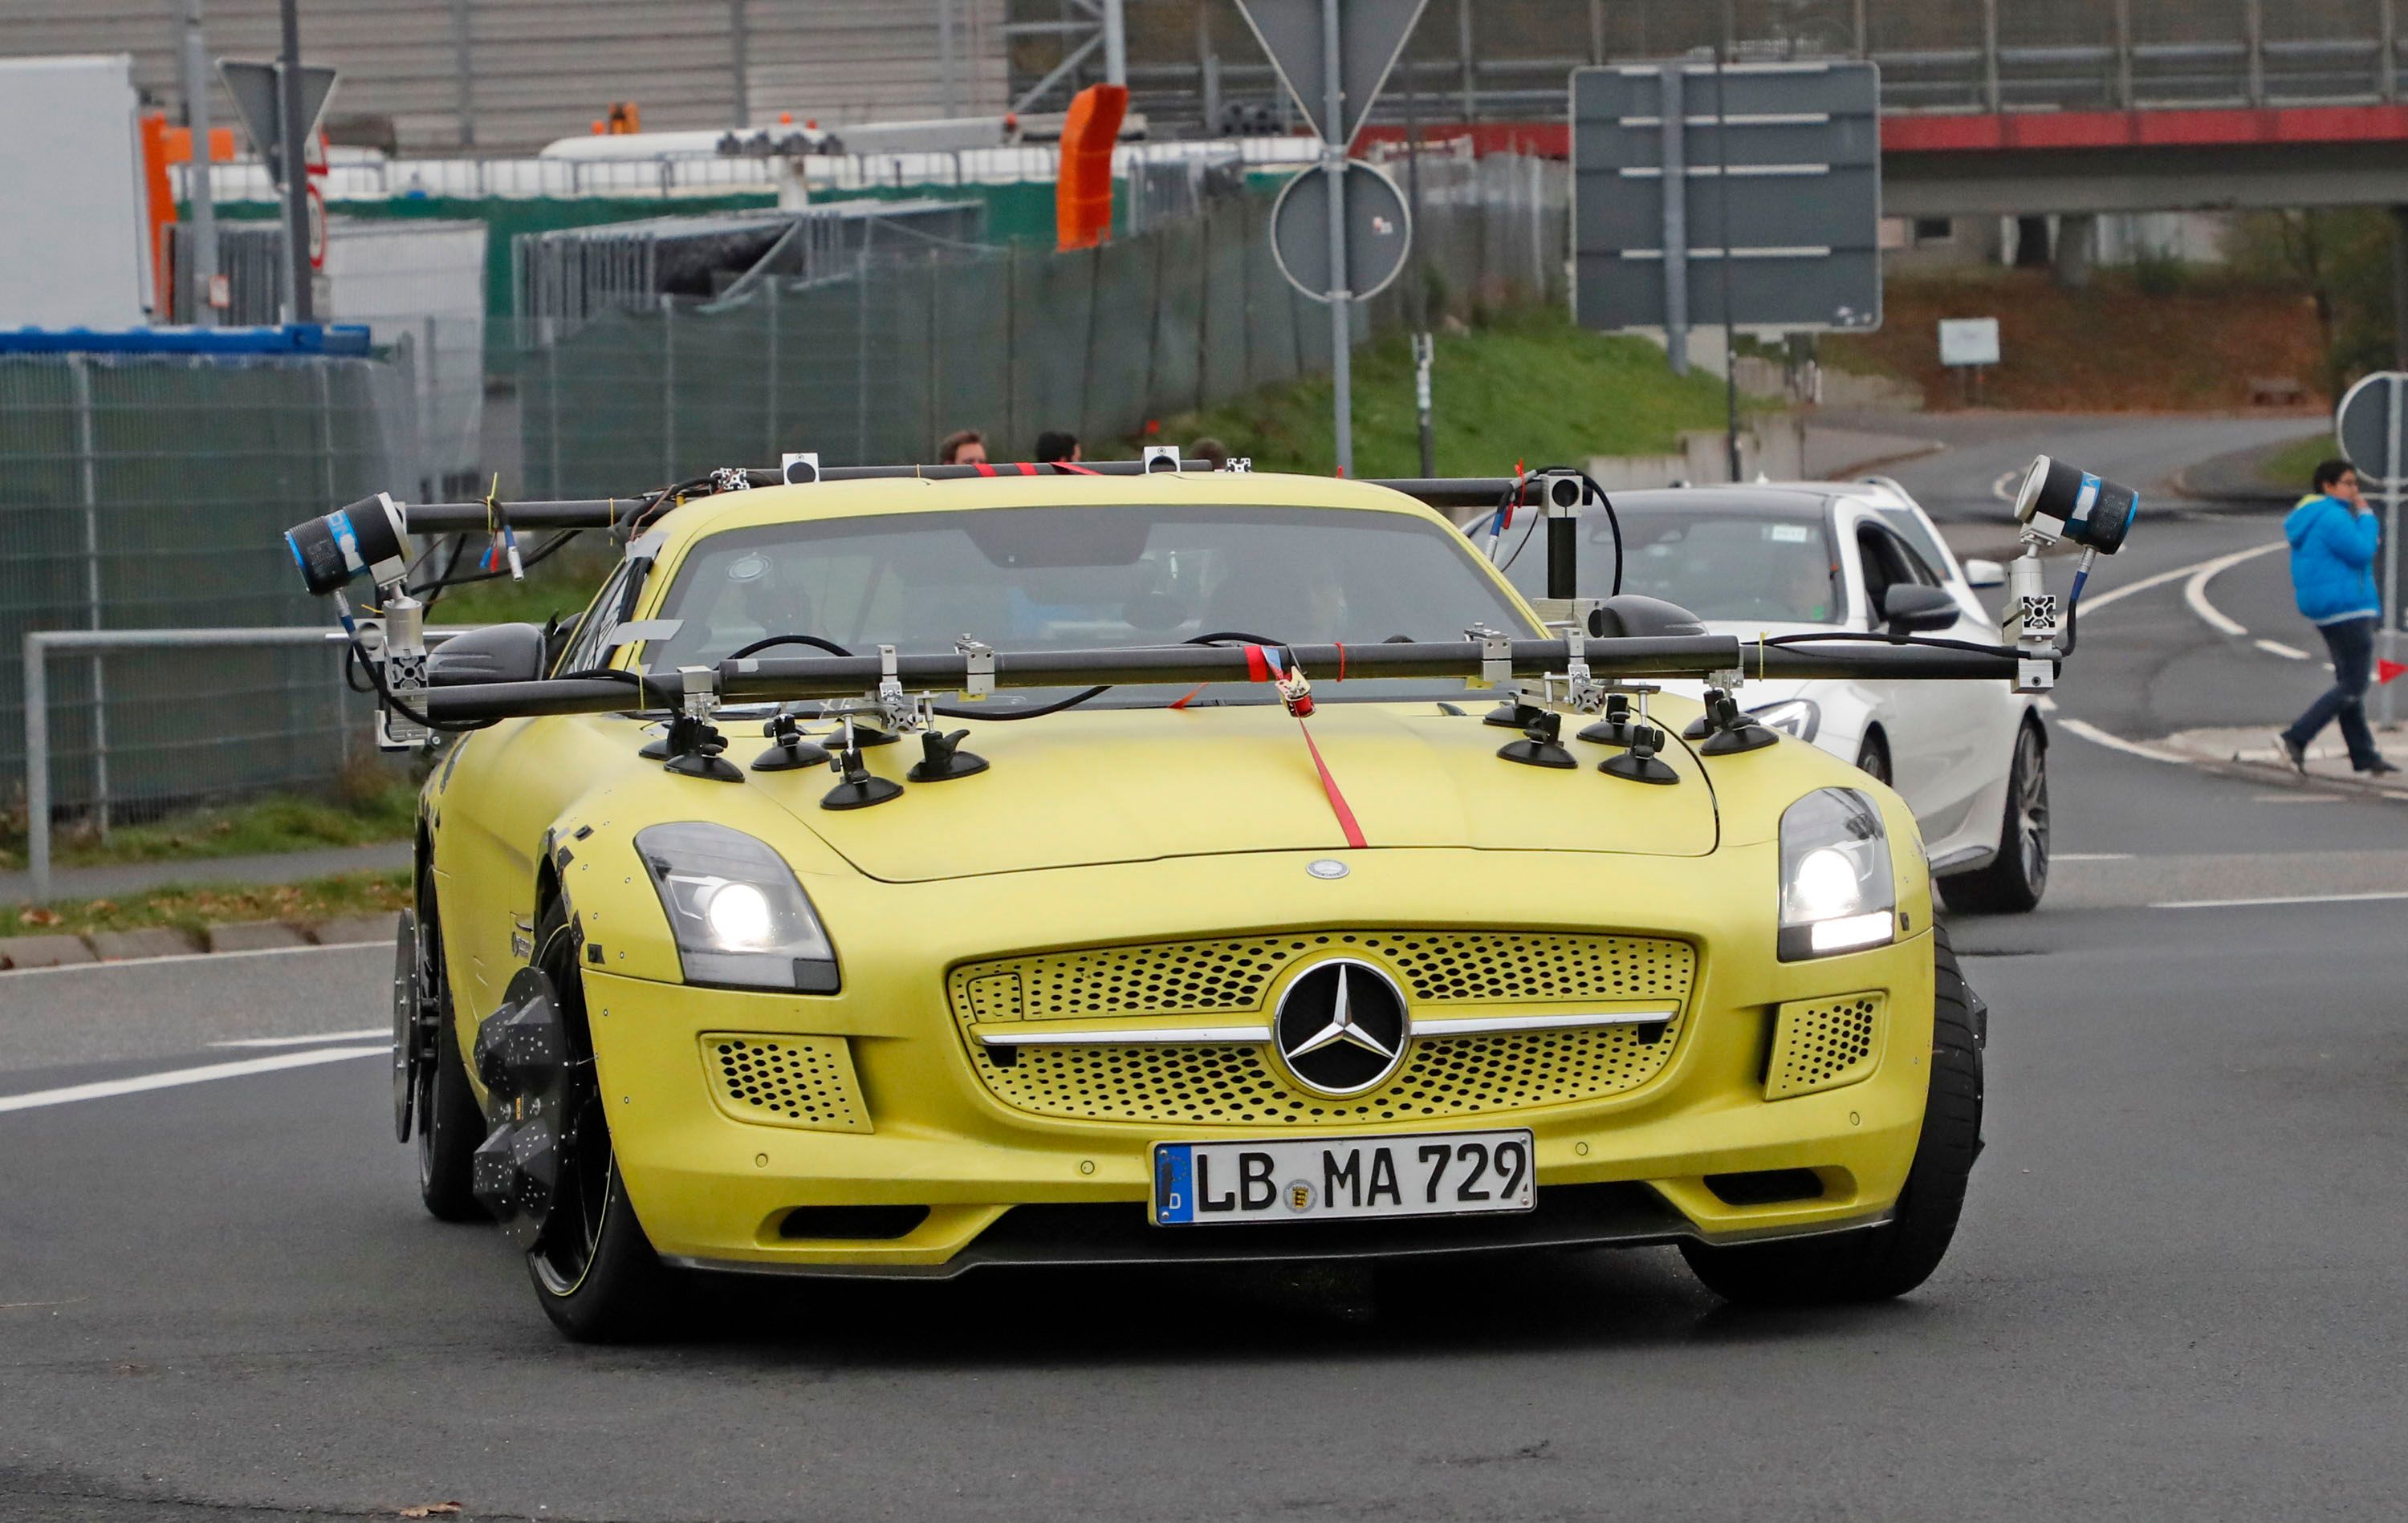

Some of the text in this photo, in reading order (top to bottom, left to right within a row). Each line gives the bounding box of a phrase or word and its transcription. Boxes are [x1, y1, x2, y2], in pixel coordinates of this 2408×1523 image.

[1197, 1152, 1277, 1212] LB
[1323, 1147, 1401, 1208] MA
[1418, 1141, 1526, 1203] 729
[1169, 1192, 1182, 1210] D
